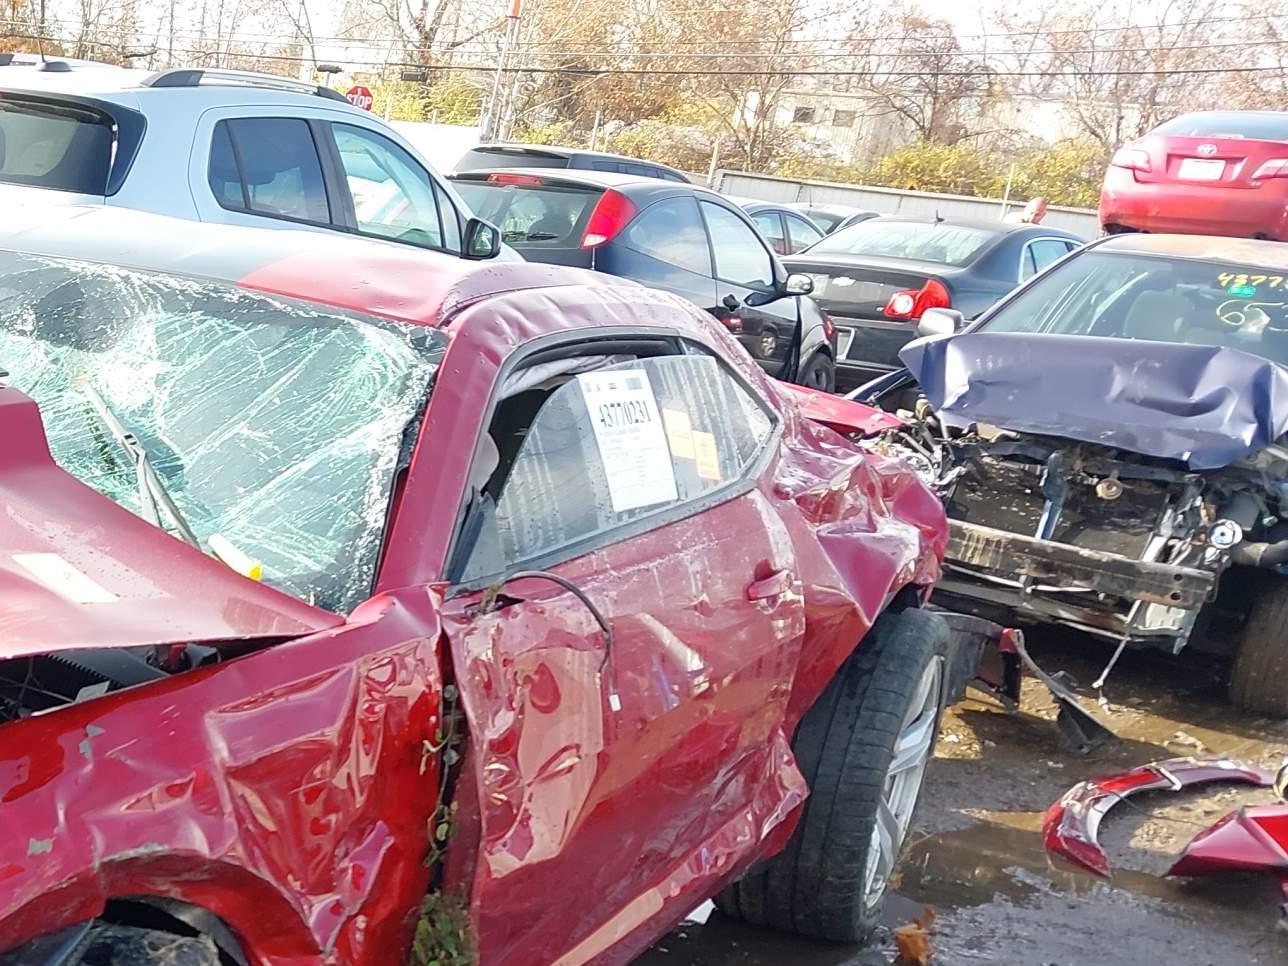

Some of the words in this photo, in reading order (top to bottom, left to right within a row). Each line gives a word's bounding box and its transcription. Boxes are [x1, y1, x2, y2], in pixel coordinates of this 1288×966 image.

[346, 93, 372, 108] STOP
[1217, 272, 1288, 289] 4377
[599, 400, 651, 427] 43770231
